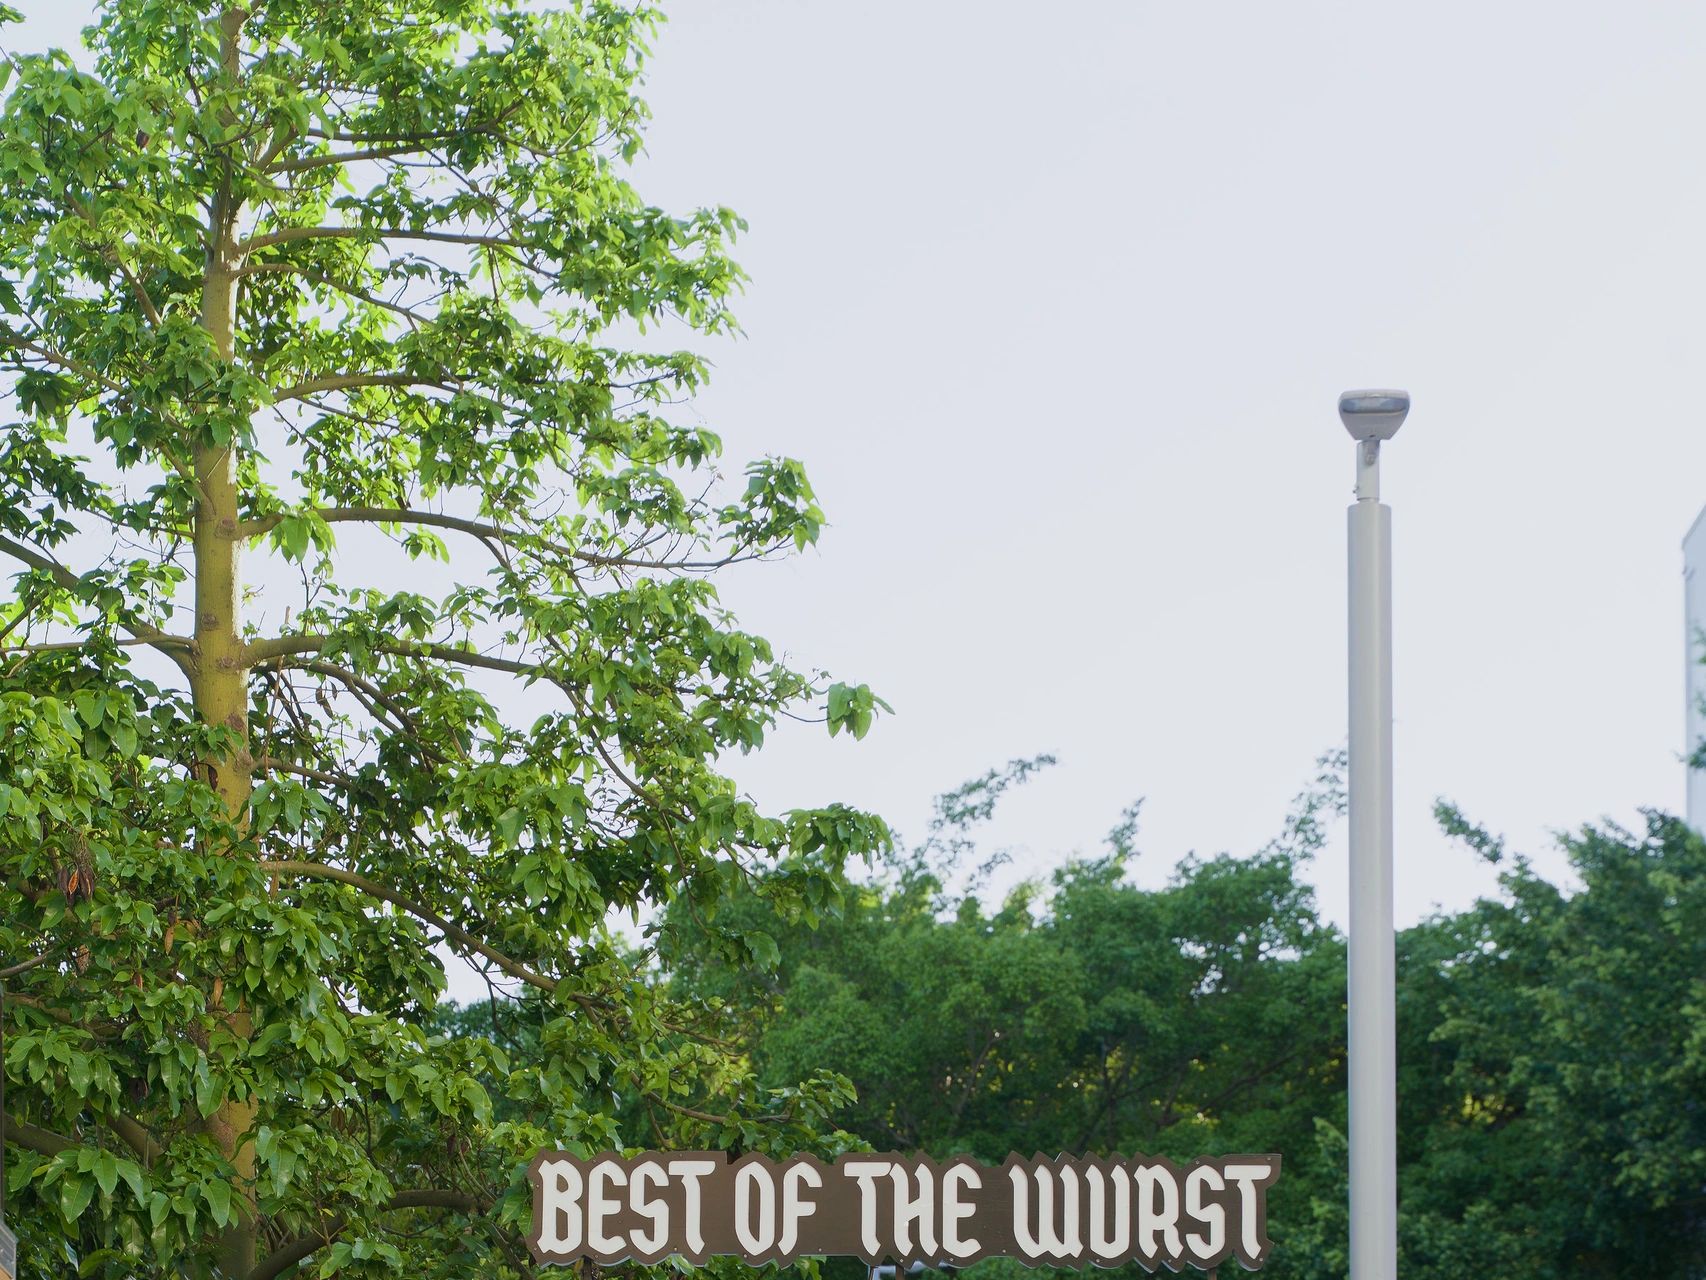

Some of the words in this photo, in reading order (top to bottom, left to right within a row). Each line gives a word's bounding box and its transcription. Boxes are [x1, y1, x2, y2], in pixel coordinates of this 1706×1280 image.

[537, 1159, 715, 1256] BEST
[735, 1159, 823, 1257] OF
[844, 1160, 982, 1257] THE
[1008, 1161, 1272, 1260] WURST
